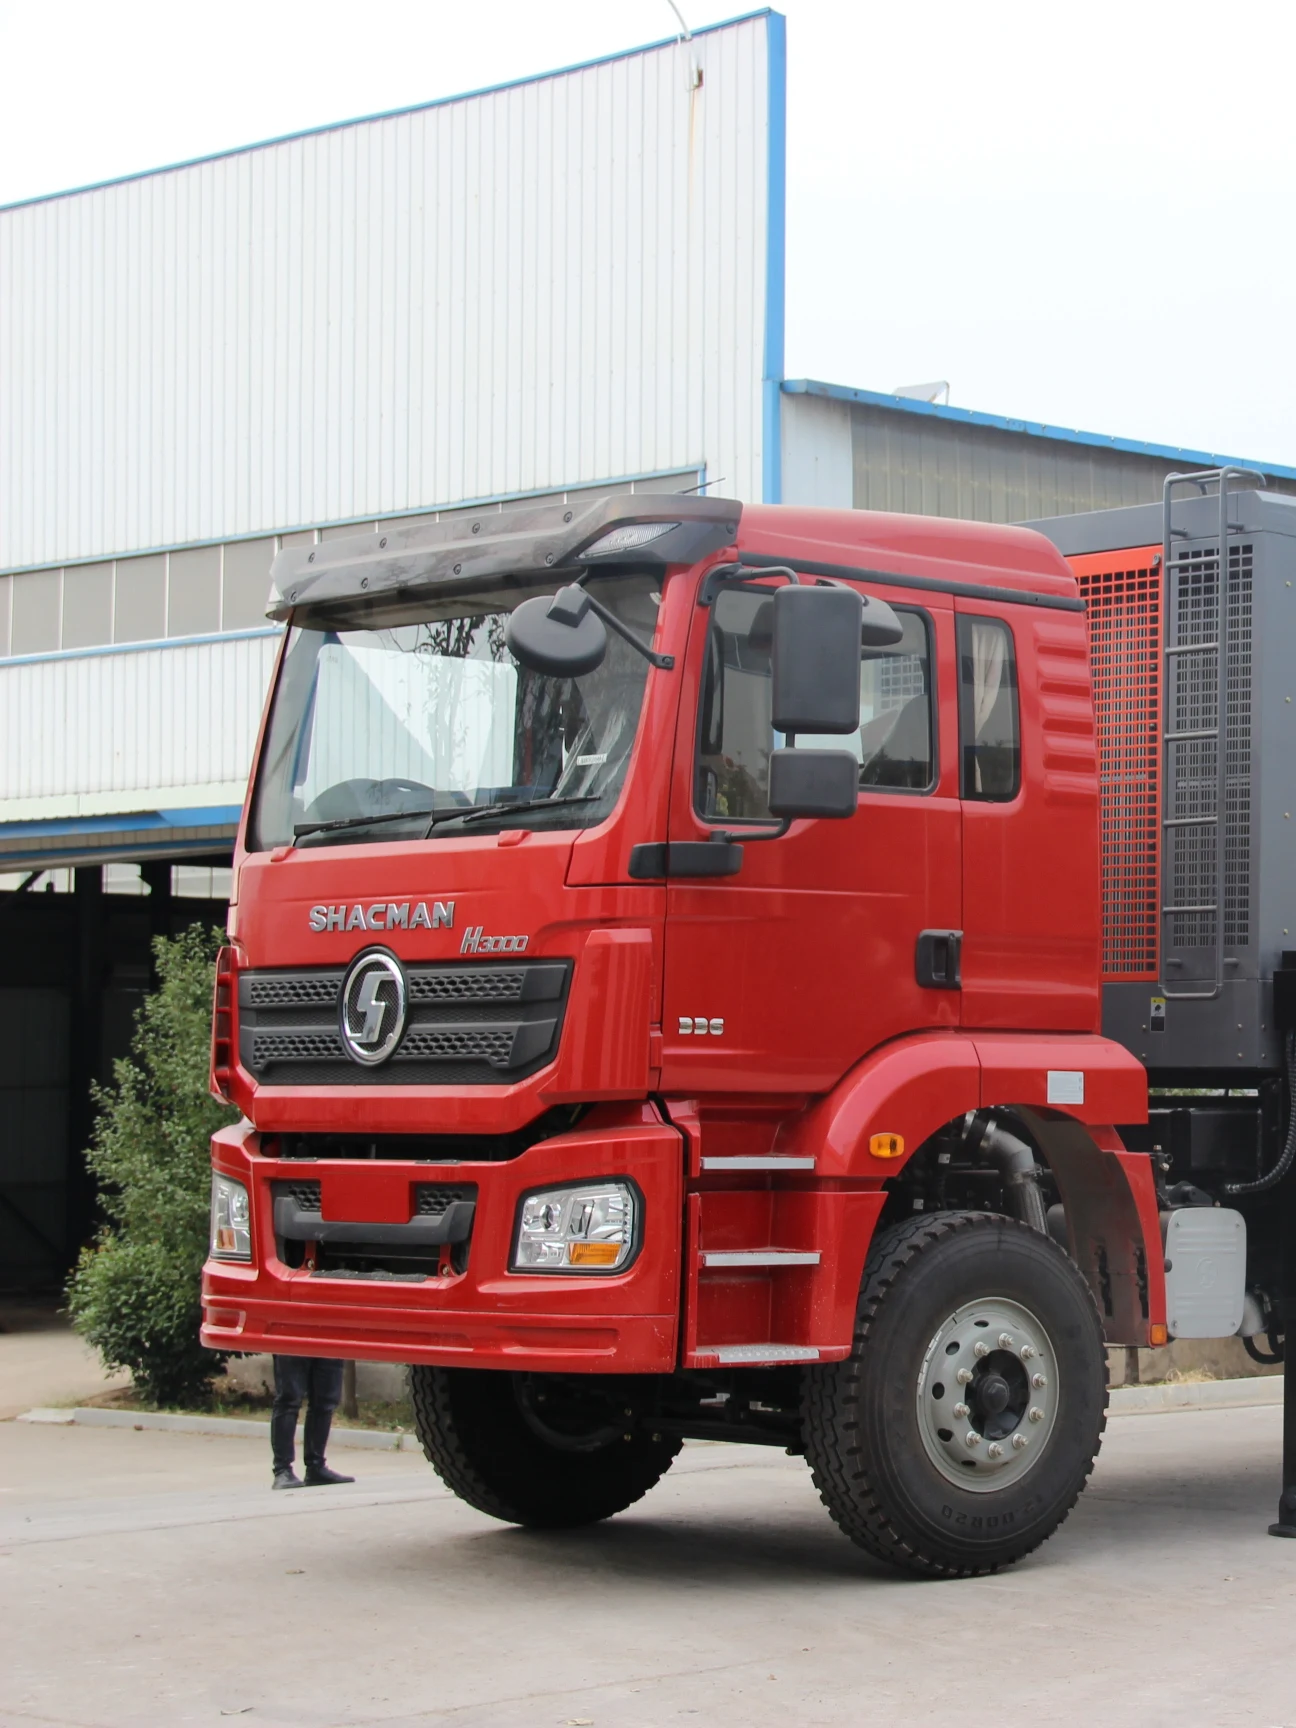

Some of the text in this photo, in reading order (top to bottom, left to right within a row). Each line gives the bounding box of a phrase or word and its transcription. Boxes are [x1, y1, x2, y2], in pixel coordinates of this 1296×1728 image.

[309, 902, 455, 932] SHACMAN
[460, 926, 529, 953] H3000
[678, 1016, 724, 1035] 336
